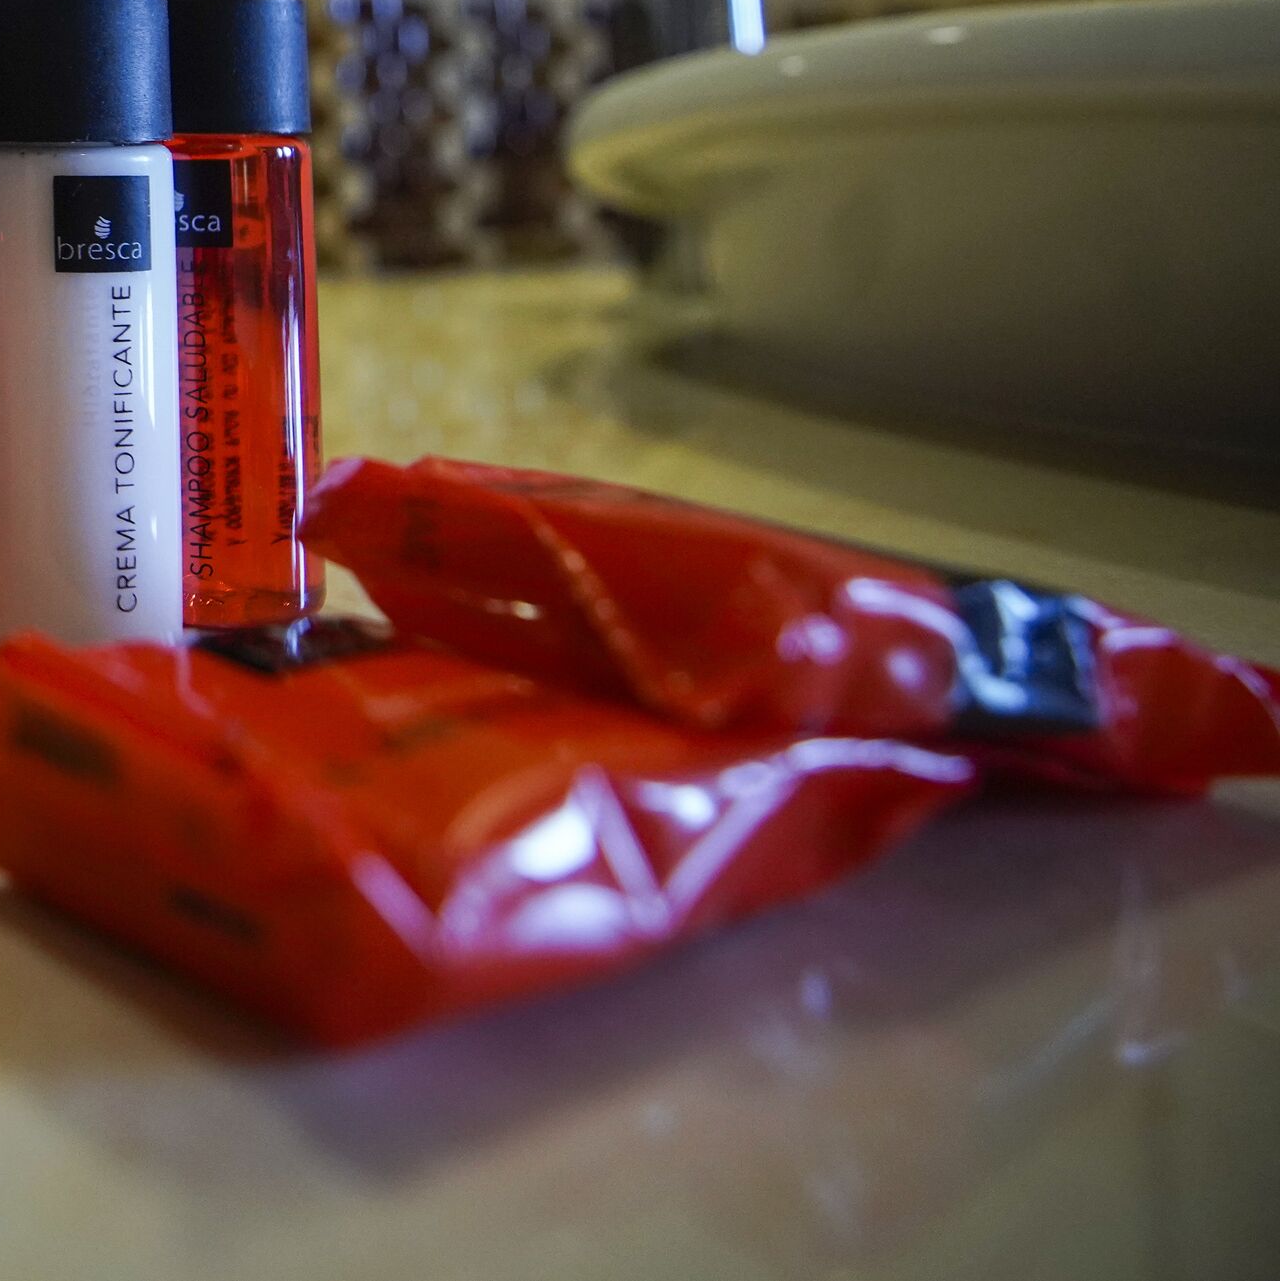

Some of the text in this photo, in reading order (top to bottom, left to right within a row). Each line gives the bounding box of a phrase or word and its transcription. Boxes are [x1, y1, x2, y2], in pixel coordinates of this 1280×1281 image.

[57, 236, 143, 261] bresca
[177, 213, 221, 233] sca
[111, 284, 139, 614] CREMA TONIFICANTE
[181, 259, 214, 578] SHAMPOO SALUDABLE
